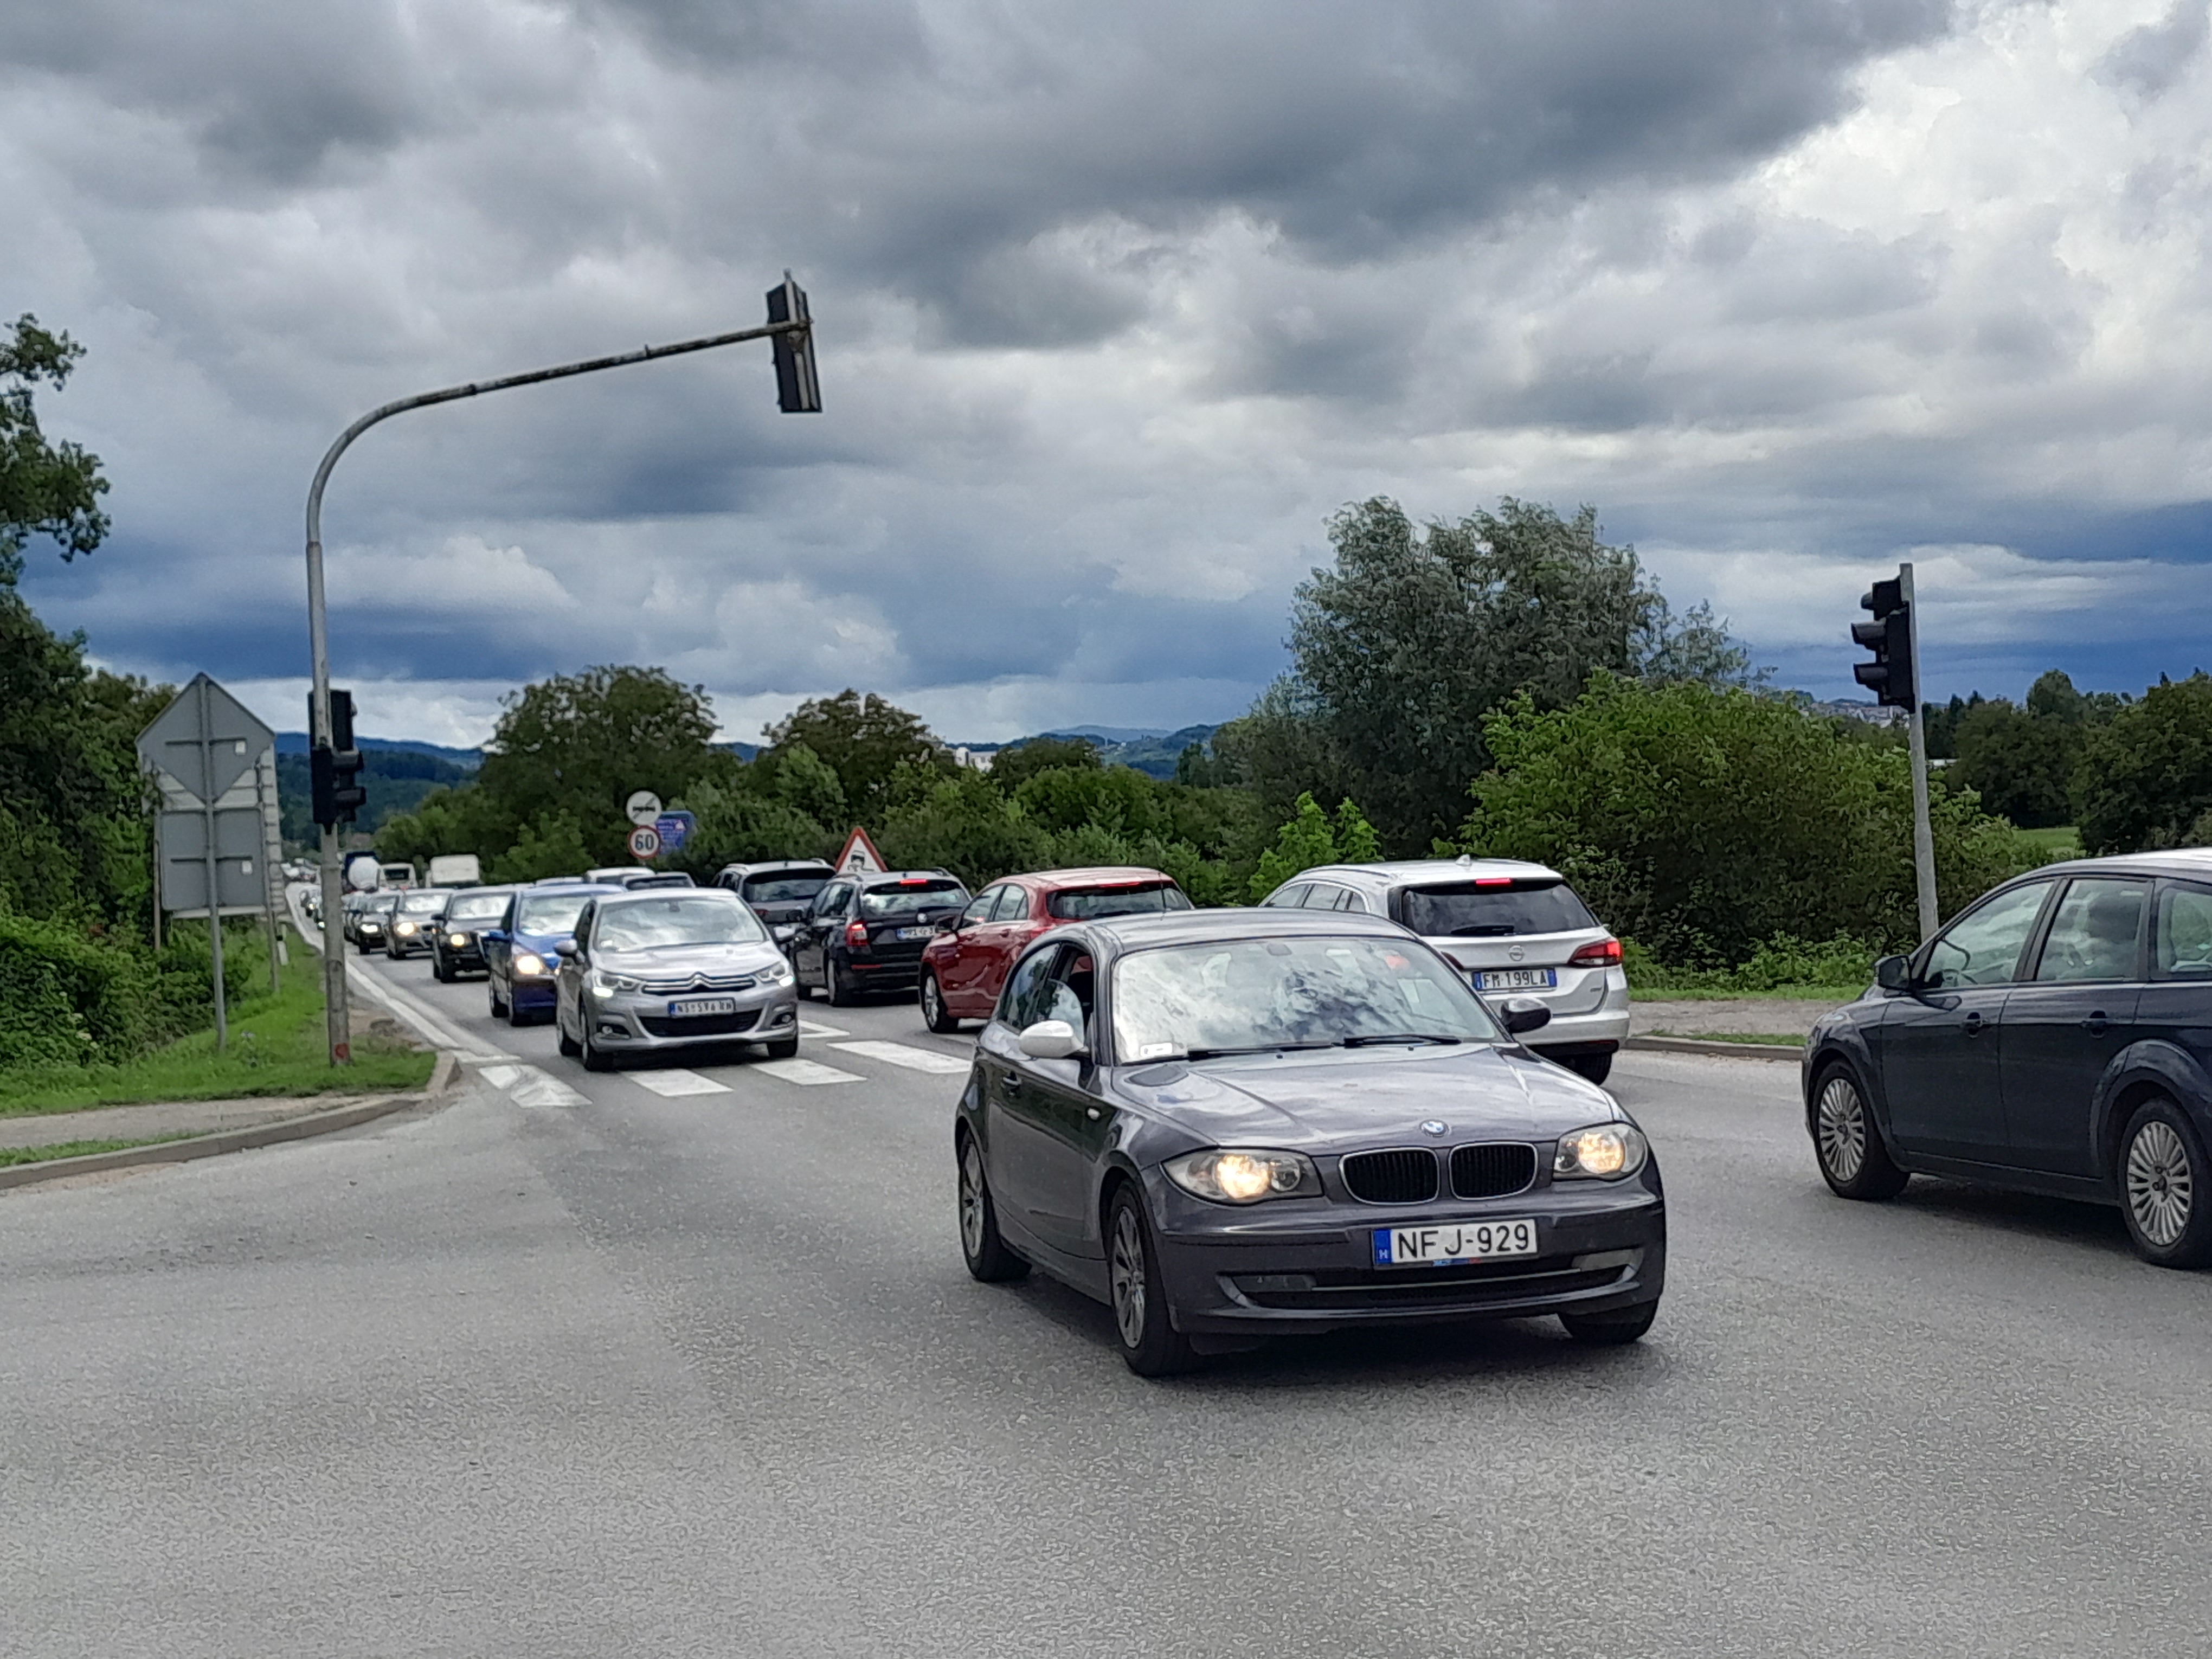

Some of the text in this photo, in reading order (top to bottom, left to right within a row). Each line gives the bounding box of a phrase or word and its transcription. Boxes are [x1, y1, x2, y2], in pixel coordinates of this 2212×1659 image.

[635, 834, 654, 851] 60
[1397, 1223, 1529, 1258] NFJ-929
[1379, 1249, 1388, 1260] H
